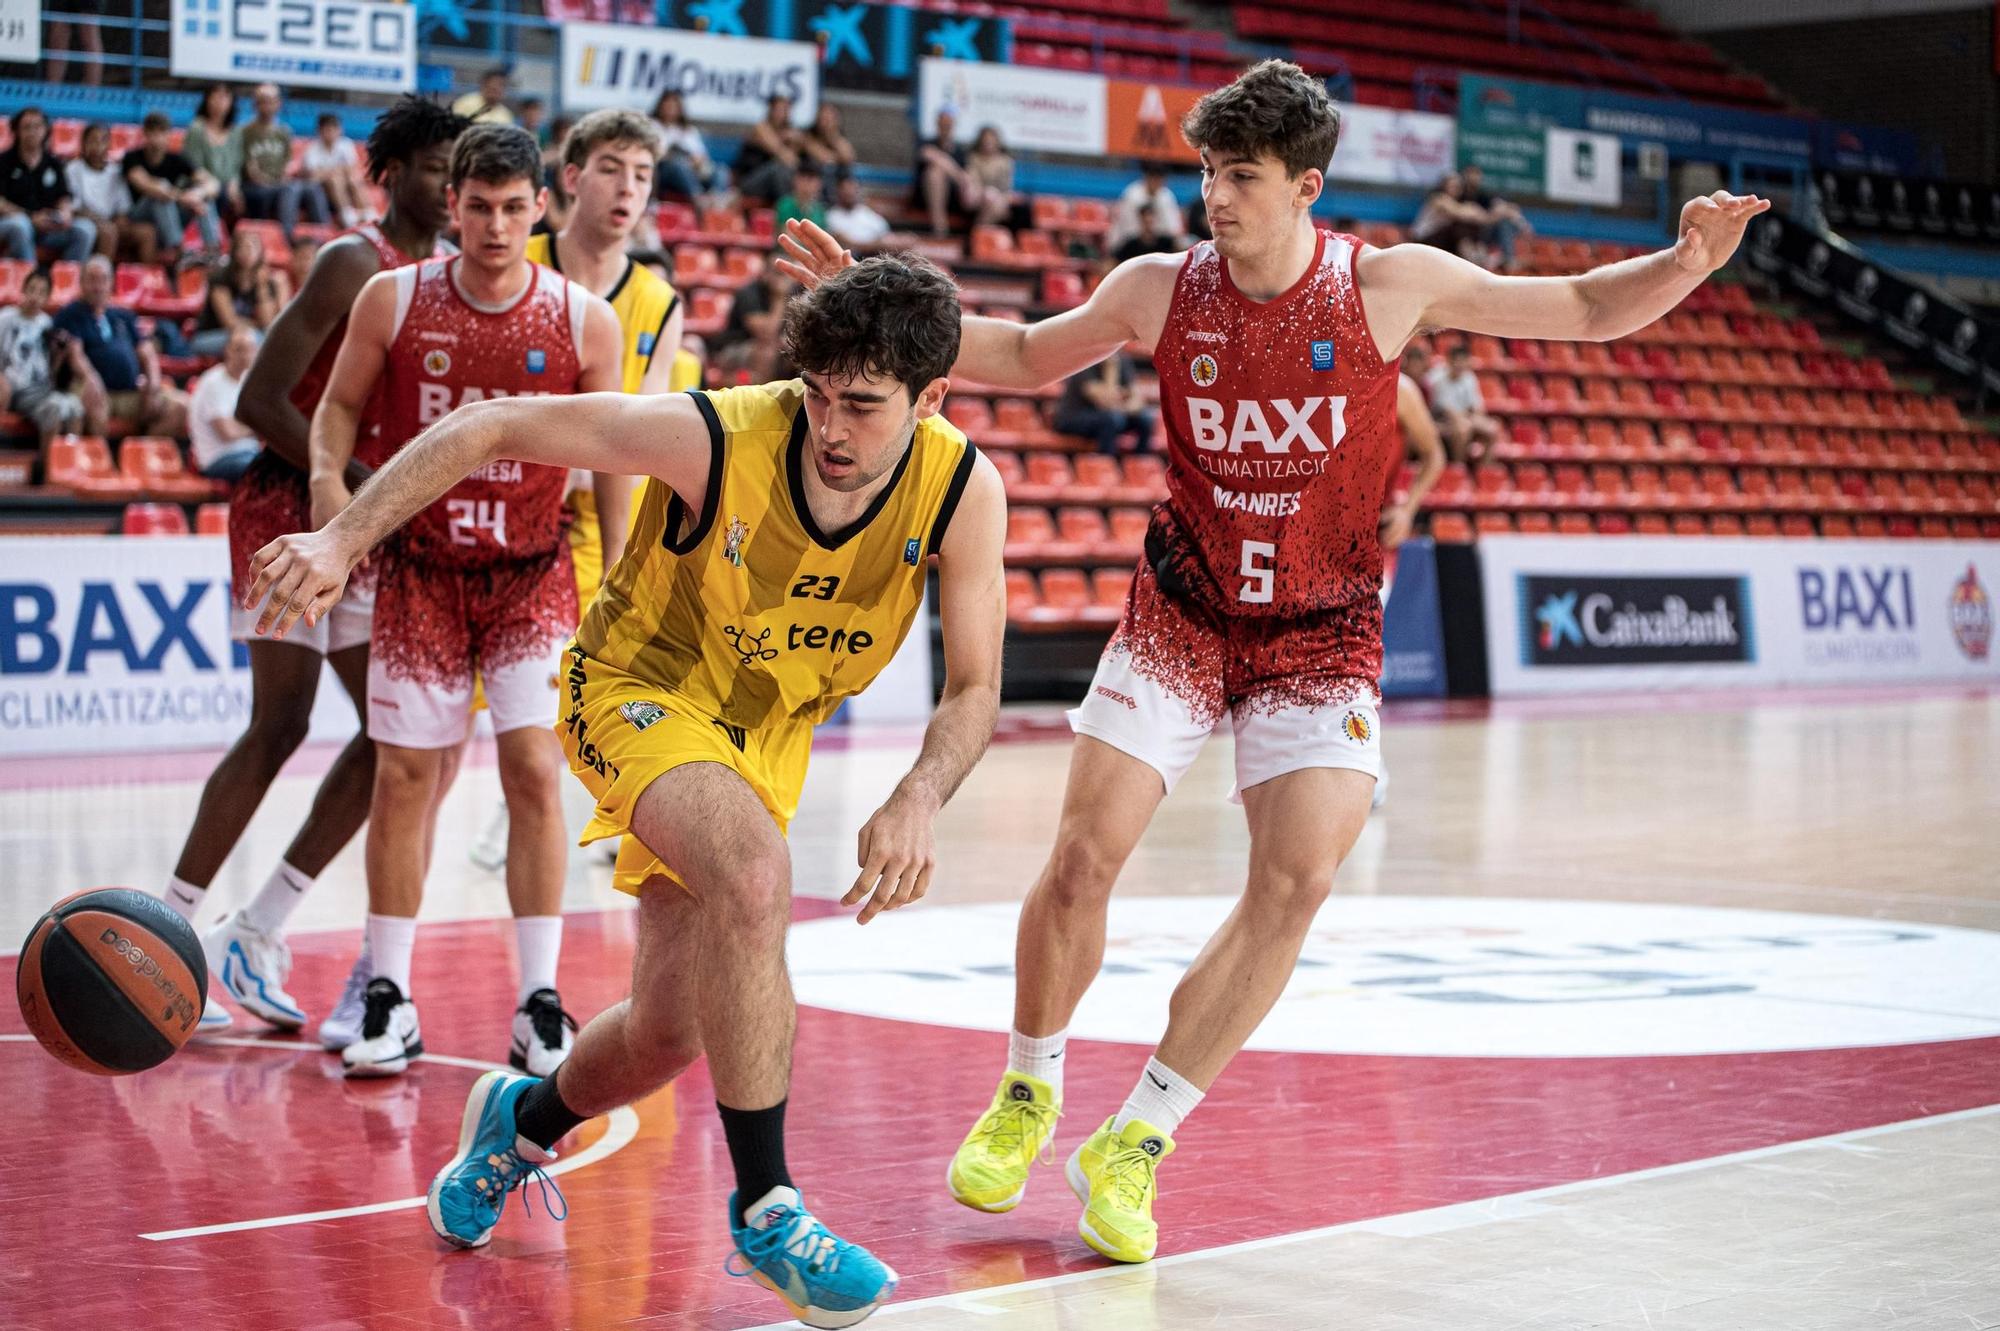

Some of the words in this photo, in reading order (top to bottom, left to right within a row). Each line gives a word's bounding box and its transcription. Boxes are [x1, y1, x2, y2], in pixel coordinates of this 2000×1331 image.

[1186, 395, 1347, 453] BAXI
[447, 499, 507, 547] 24
[790, 574, 841, 601] 23
[1239, 539, 1276, 604] 5
[1799, 568, 1915, 630] BAXI
[1581, 592, 1738, 647] CaixaBank
